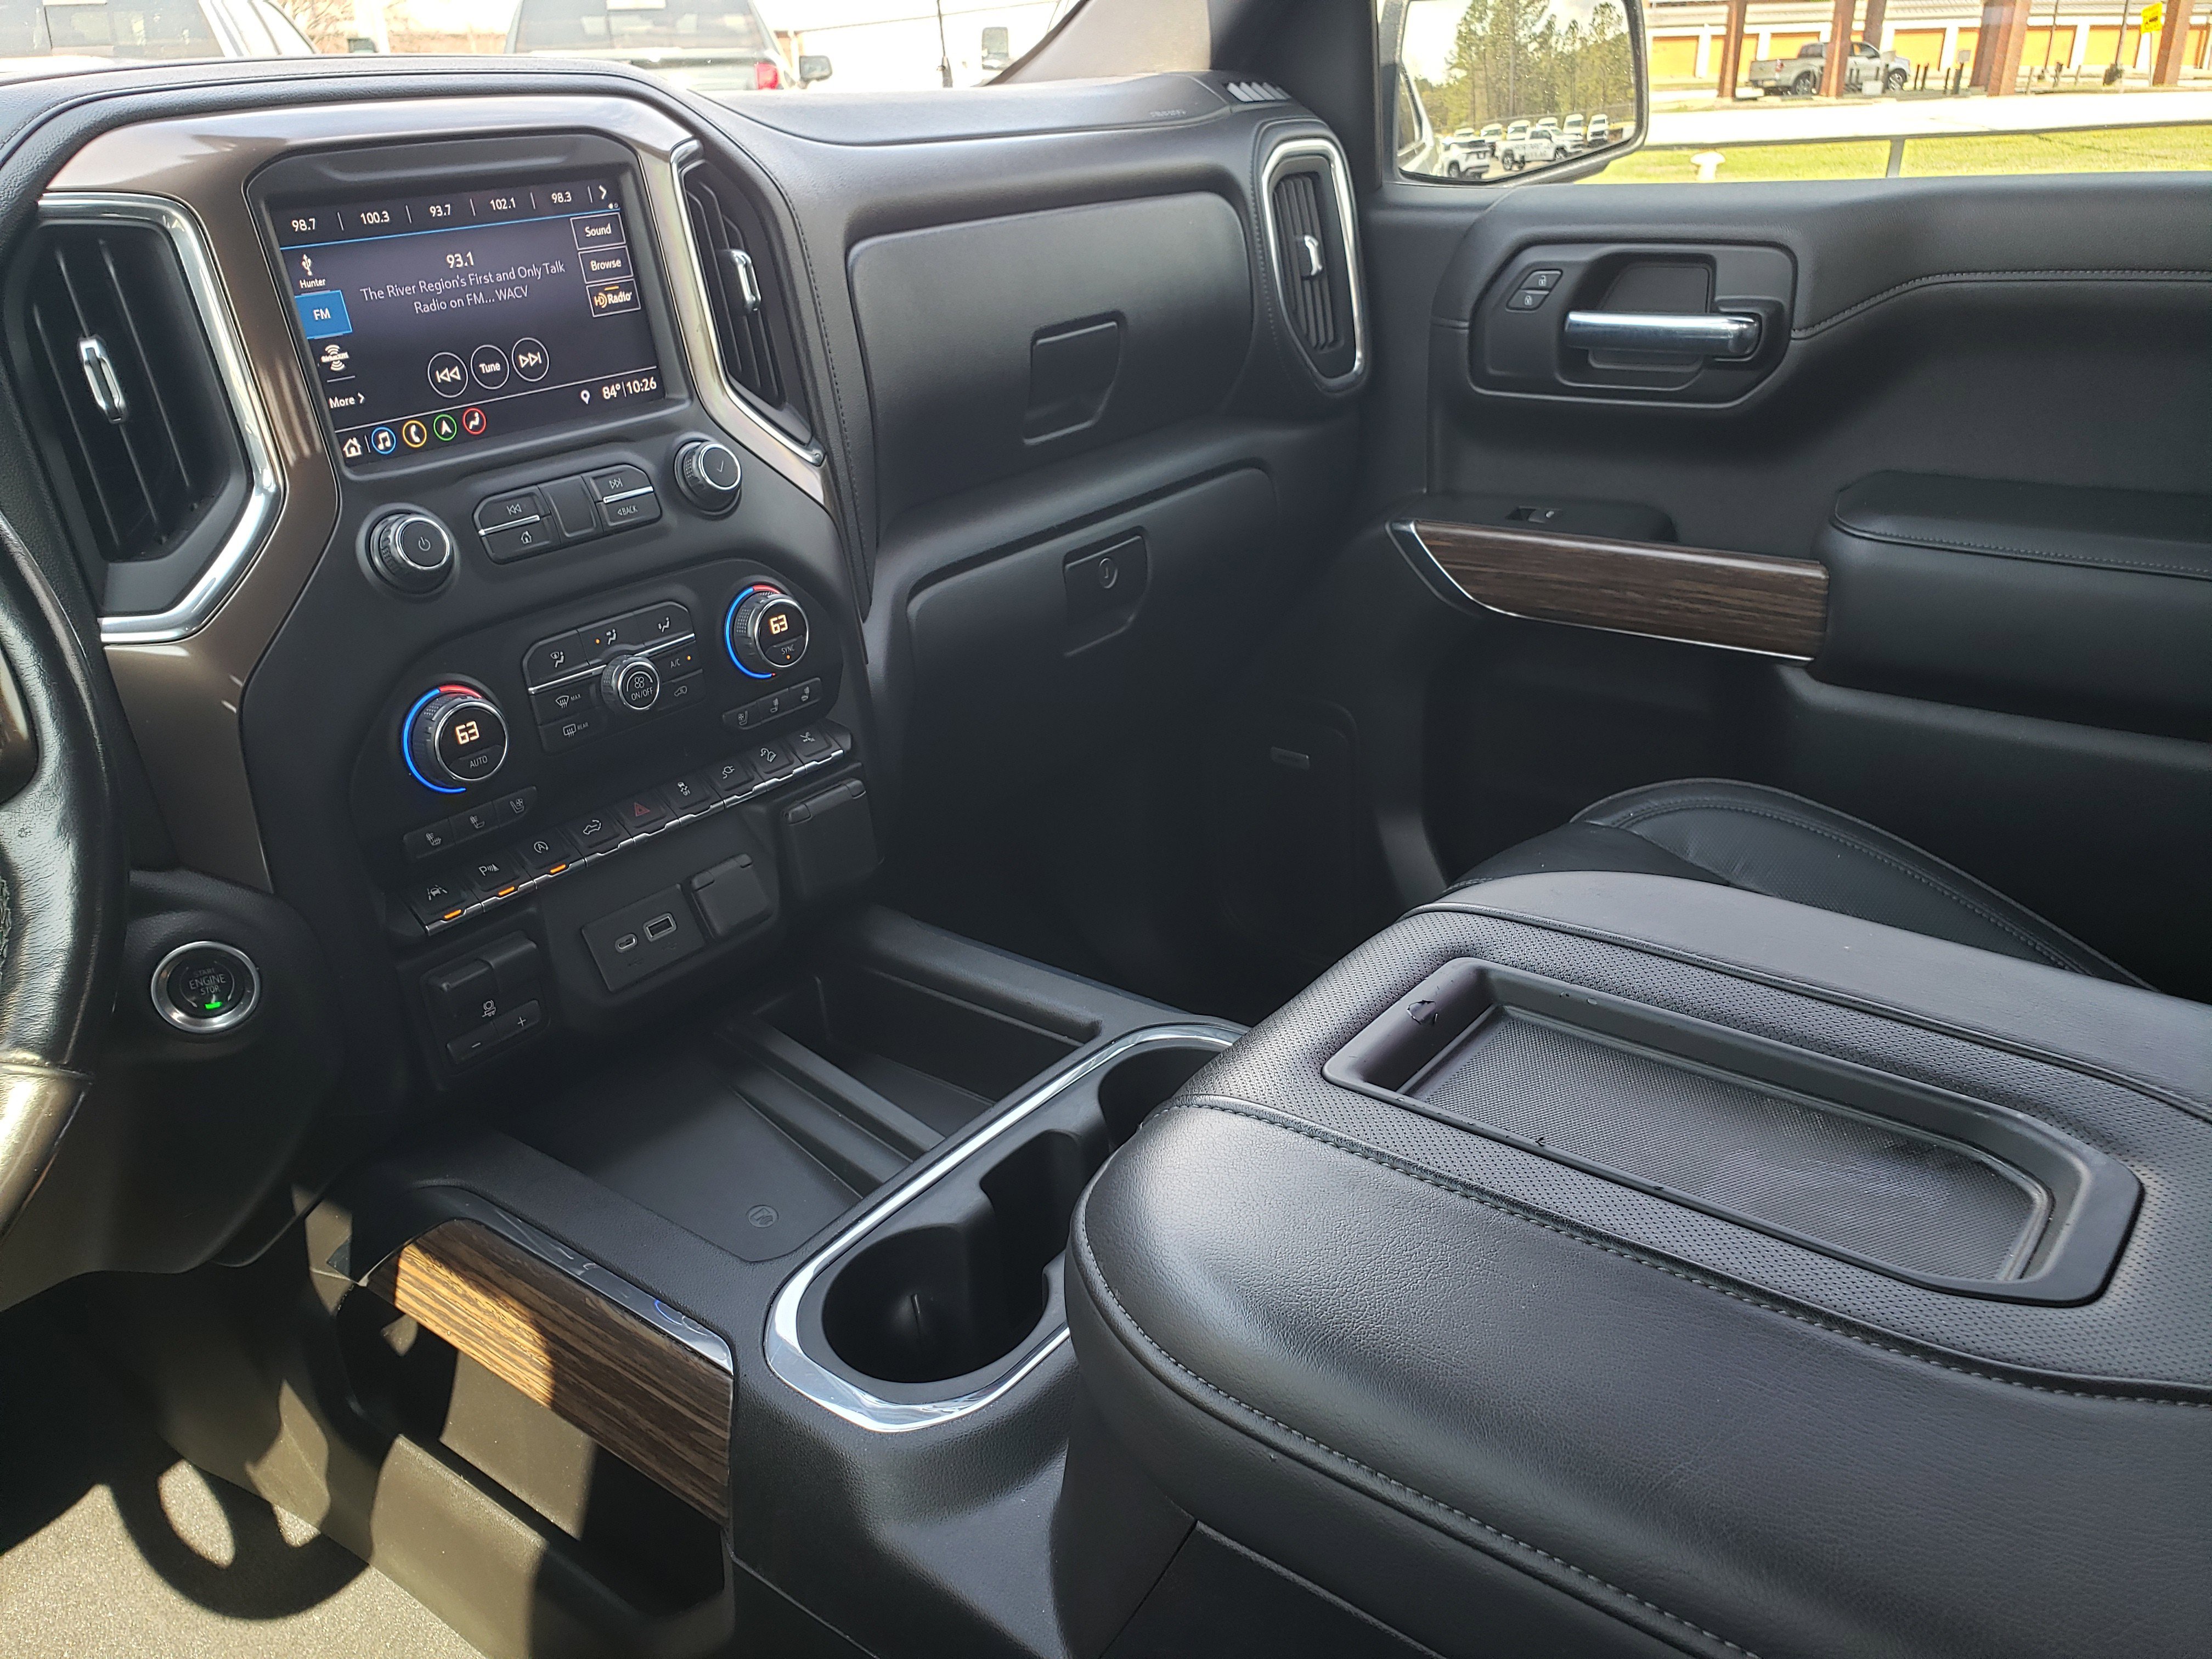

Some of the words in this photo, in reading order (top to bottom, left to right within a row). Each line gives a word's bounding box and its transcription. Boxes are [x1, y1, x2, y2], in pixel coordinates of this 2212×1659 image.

[489, 197, 516, 211] 102.1
[551, 191, 572, 204] 98.3
[360, 211, 390, 224] 100.3
[429, 204, 451, 217] 93.7
[292, 218, 316, 232] 98.7
[584, 223, 612, 237] Sound
[445, 251, 475, 268] 93.1
[590, 258, 622, 272] Browse
[300, 278, 326, 289] Hunter
[360, 287, 385, 301] The
[386, 284, 416, 297] River
[419, 274, 467, 295] Region's
[469, 272, 495, 286] First
[496, 266, 516, 282] and
[517, 264, 542, 280] Only
[542, 260, 566, 275] Talk
[414, 298, 447, 314] Radio
[450, 298, 465, 309] on
[466, 291, 495, 306] FM...
[495, 285, 528, 301] WACV
[594, 292, 607, 308] HD
[607, 290, 631, 304] Radio
[313, 308, 331, 321] FM
[478, 362, 501, 374] Tune
[602, 383, 621, 400] 84°
[627, 376, 657, 394] 10:26
[329, 396, 356, 409] More
[622, 505, 638, 515] BACK
[769, 614, 788, 634] 63
[781, 644, 795, 655] SYNC
[670, 658, 680, 668] A/C
[631, 687, 653, 701] ON/OFF
[455, 720, 480, 745] 63
[470, 755, 488, 769] AUTO
[478, 865, 487, 876] P
[189, 974, 227, 990] ENGINE
[200, 985, 221, 995] STOP
